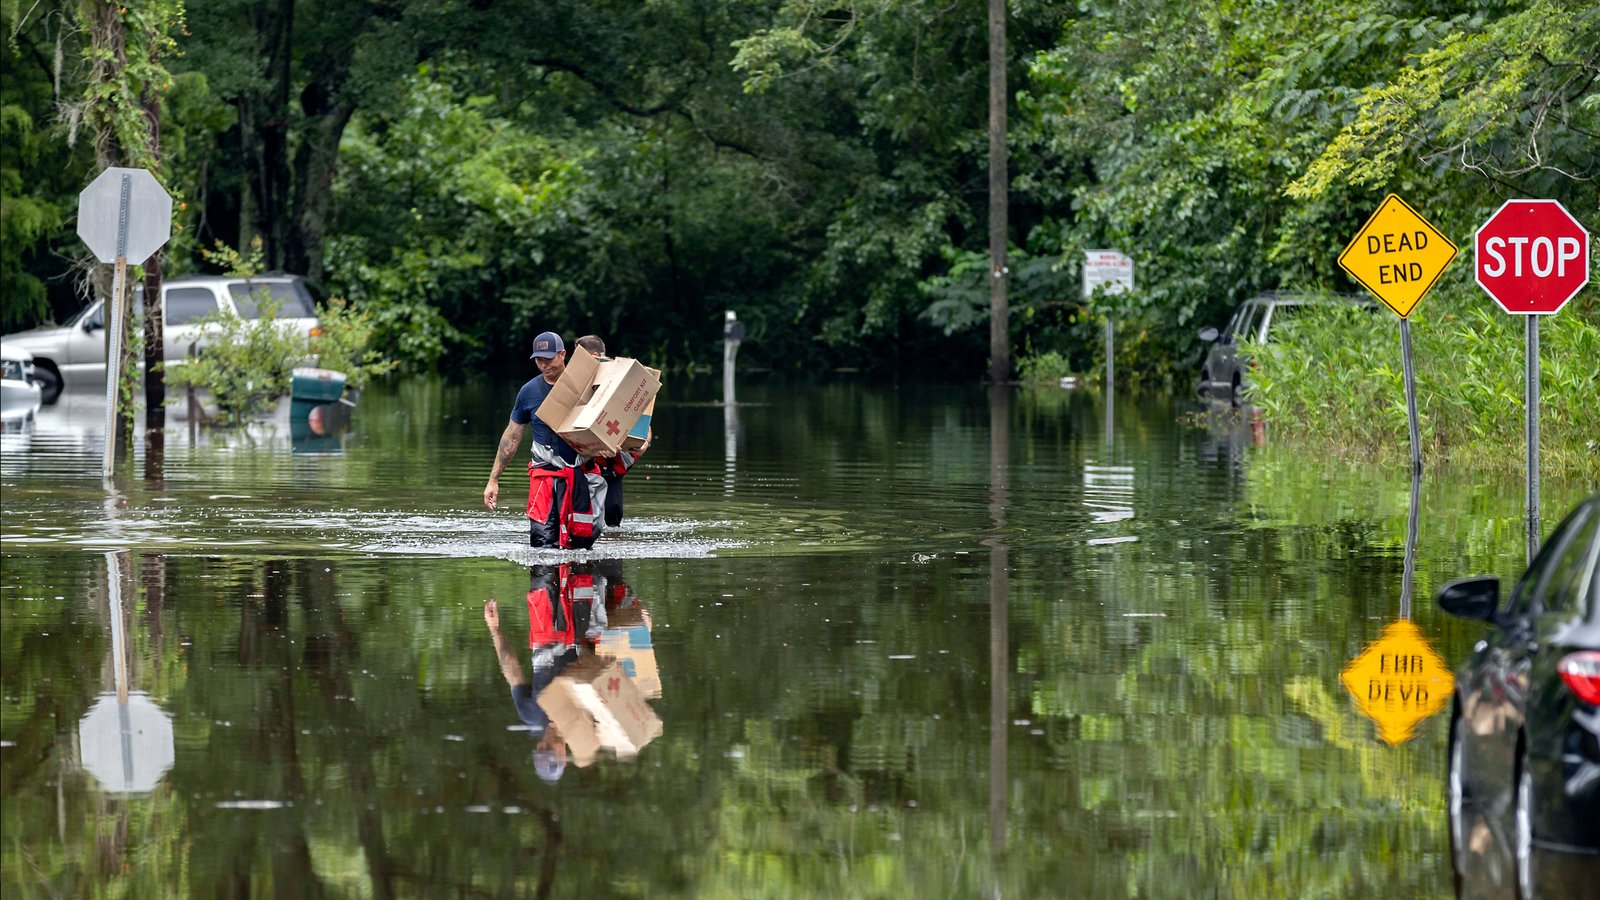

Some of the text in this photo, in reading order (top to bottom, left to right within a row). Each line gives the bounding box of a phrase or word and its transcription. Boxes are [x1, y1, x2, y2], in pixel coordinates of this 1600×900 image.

[1367, 231, 1428, 255] DEAD
[1483, 236, 1581, 278] STOP
[1379, 262, 1423, 285] END
[624, 387, 641, 412] COMFORT
